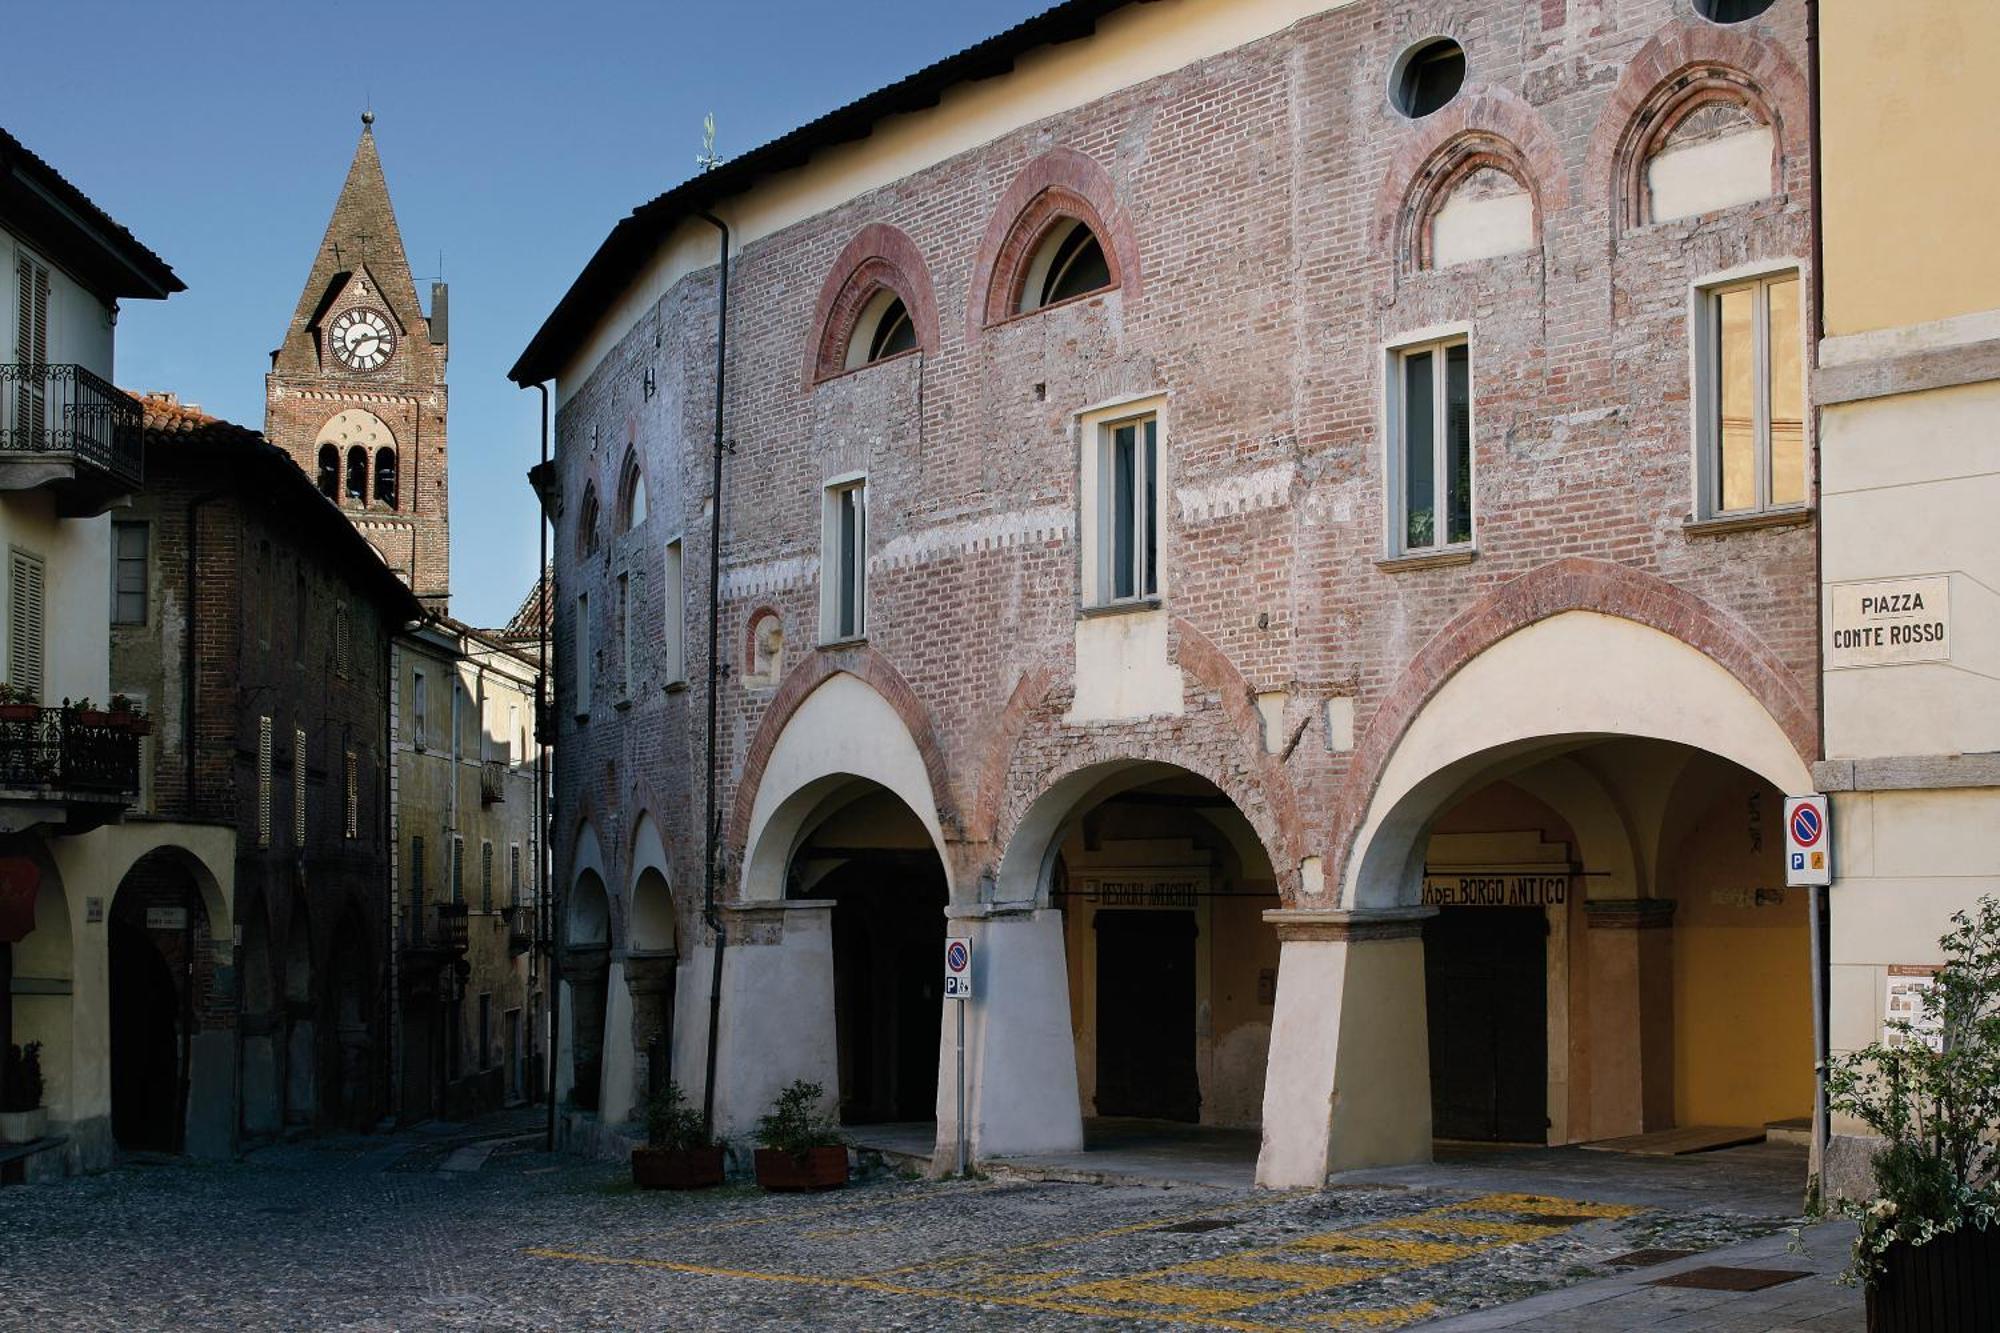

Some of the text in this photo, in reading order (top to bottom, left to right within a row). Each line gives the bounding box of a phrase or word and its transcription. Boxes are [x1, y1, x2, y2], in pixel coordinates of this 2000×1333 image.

[1862, 593, 1924, 615] PIAZZA
[1834, 622, 1944, 649] CONTE ROSSO
[1793, 855, 1802, 868] P
[1460, 879, 1505, 904] BORGO
[1509, 878, 1565, 905] ANTICO
[947, 978, 956, 993] P
